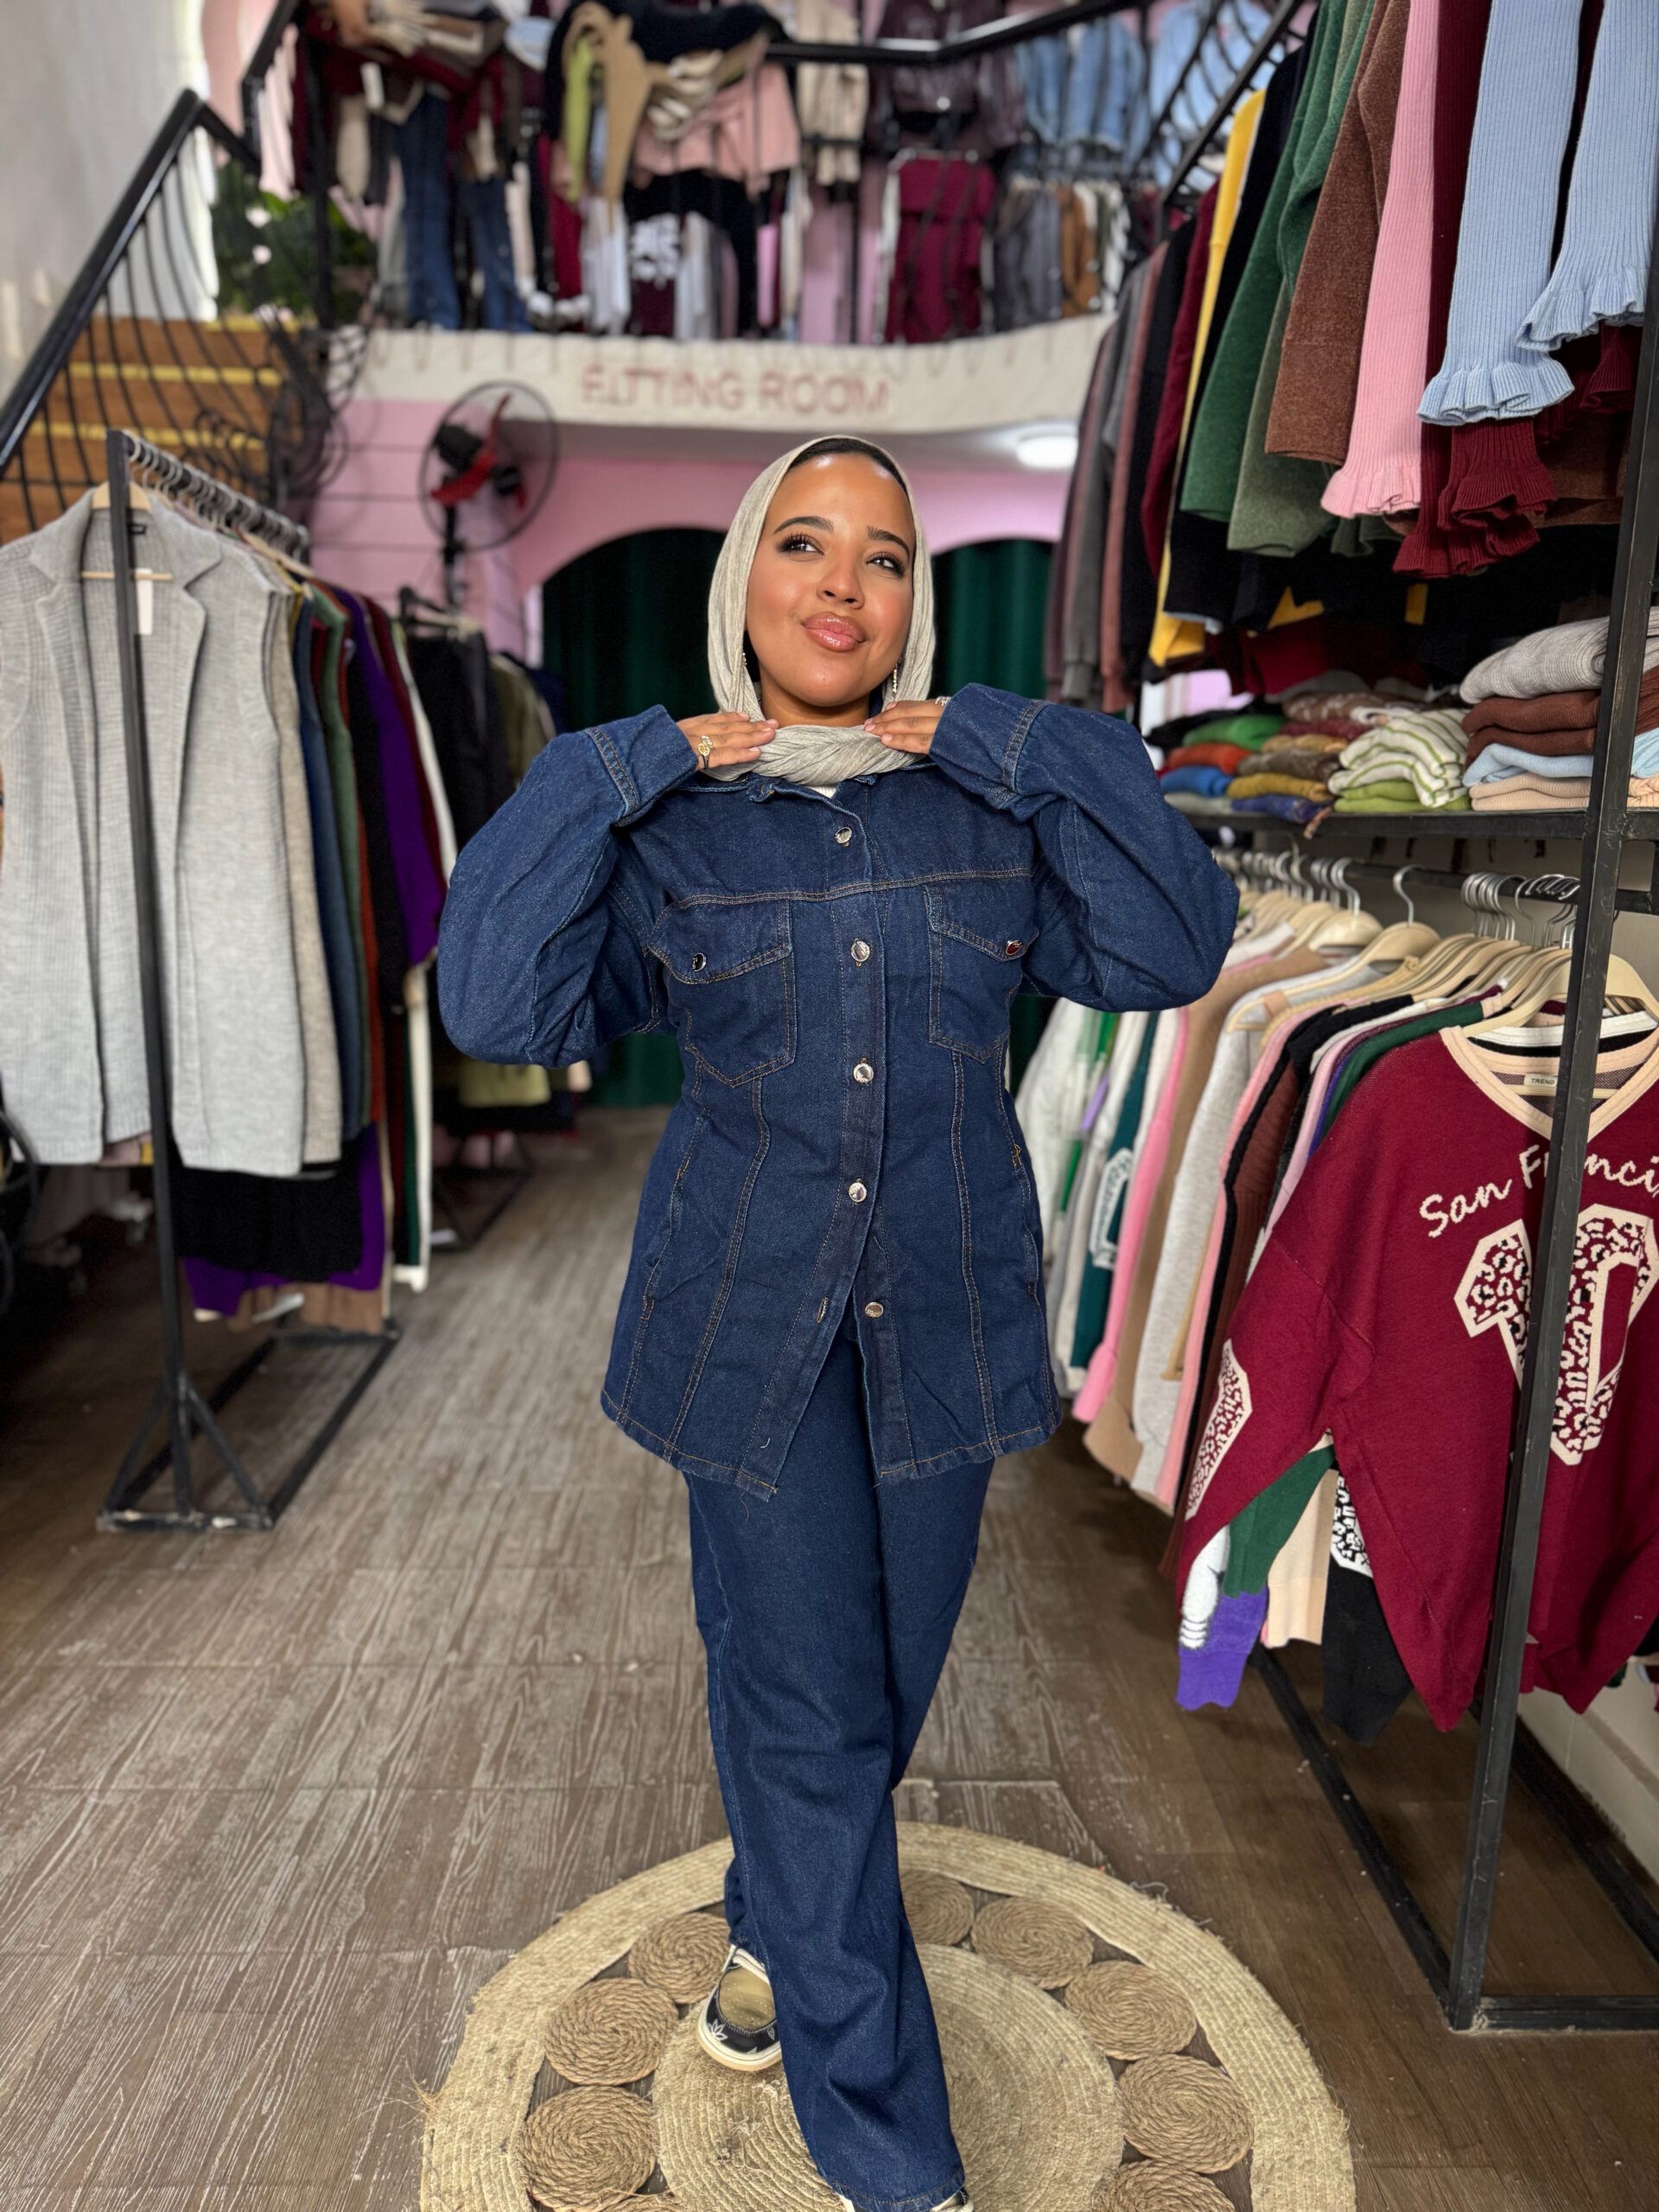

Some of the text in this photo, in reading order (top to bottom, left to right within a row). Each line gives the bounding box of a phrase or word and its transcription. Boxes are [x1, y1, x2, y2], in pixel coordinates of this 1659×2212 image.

[758, 369, 889, 415] ROOM
[1530, 1077, 1555, 1085] TREND
[1419, 1144, 1659, 1238] San Fnci
